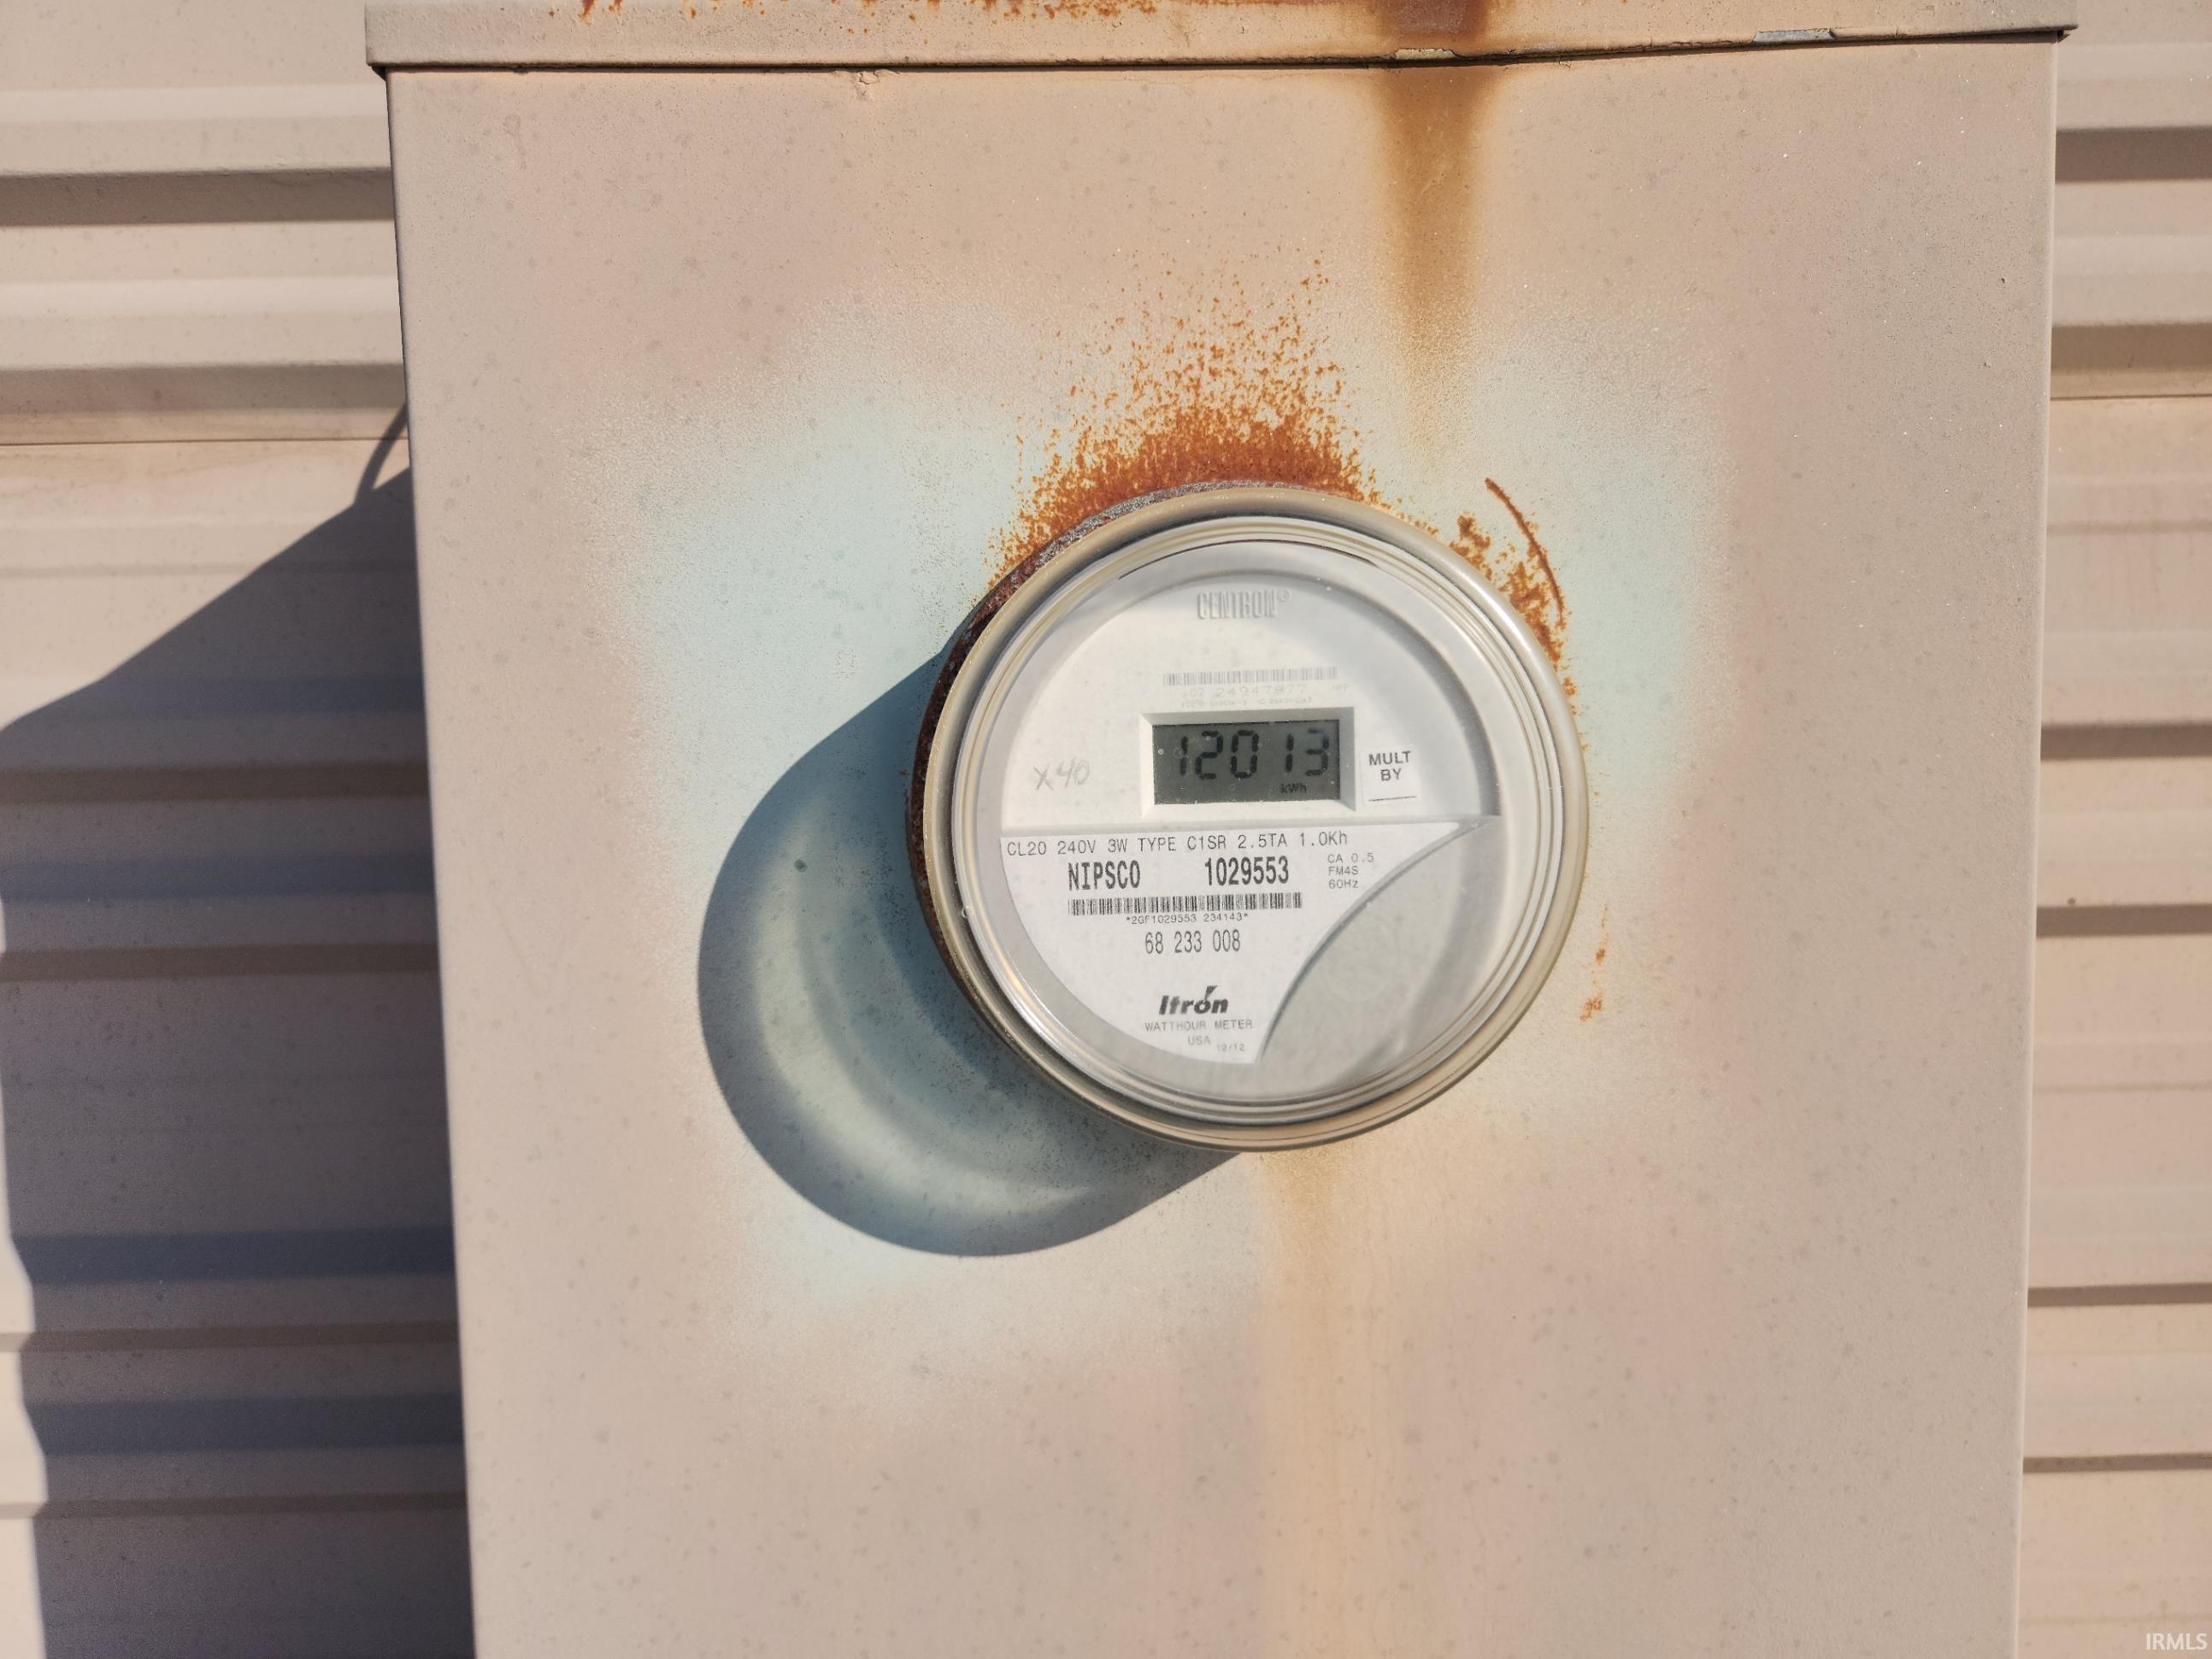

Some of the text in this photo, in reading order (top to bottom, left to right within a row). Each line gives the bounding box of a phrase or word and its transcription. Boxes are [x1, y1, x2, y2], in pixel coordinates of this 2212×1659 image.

[1180, 728, 1330, 779] 12013
[1368, 750, 1411, 765] MULT
[1381, 768, 1403, 781] BY
[1281, 783, 1307, 793] kWh
[1007, 831, 1348, 856] CL20 240V 3W TYPE C1SR 2.5TA 1.0Kh
[1327, 852, 1374, 863] CA 0.5
[1068, 855, 1289, 891] NIPSCO 1029553
[1328, 865, 1359, 875] FM4S
[1328, 879, 1359, 889] 60Hz
[1144, 929, 1240, 954] 68 233 008
[1144, 1019, 1253, 1032] WATTHOUR METER
[1187, 1036, 1211, 1046] USA
